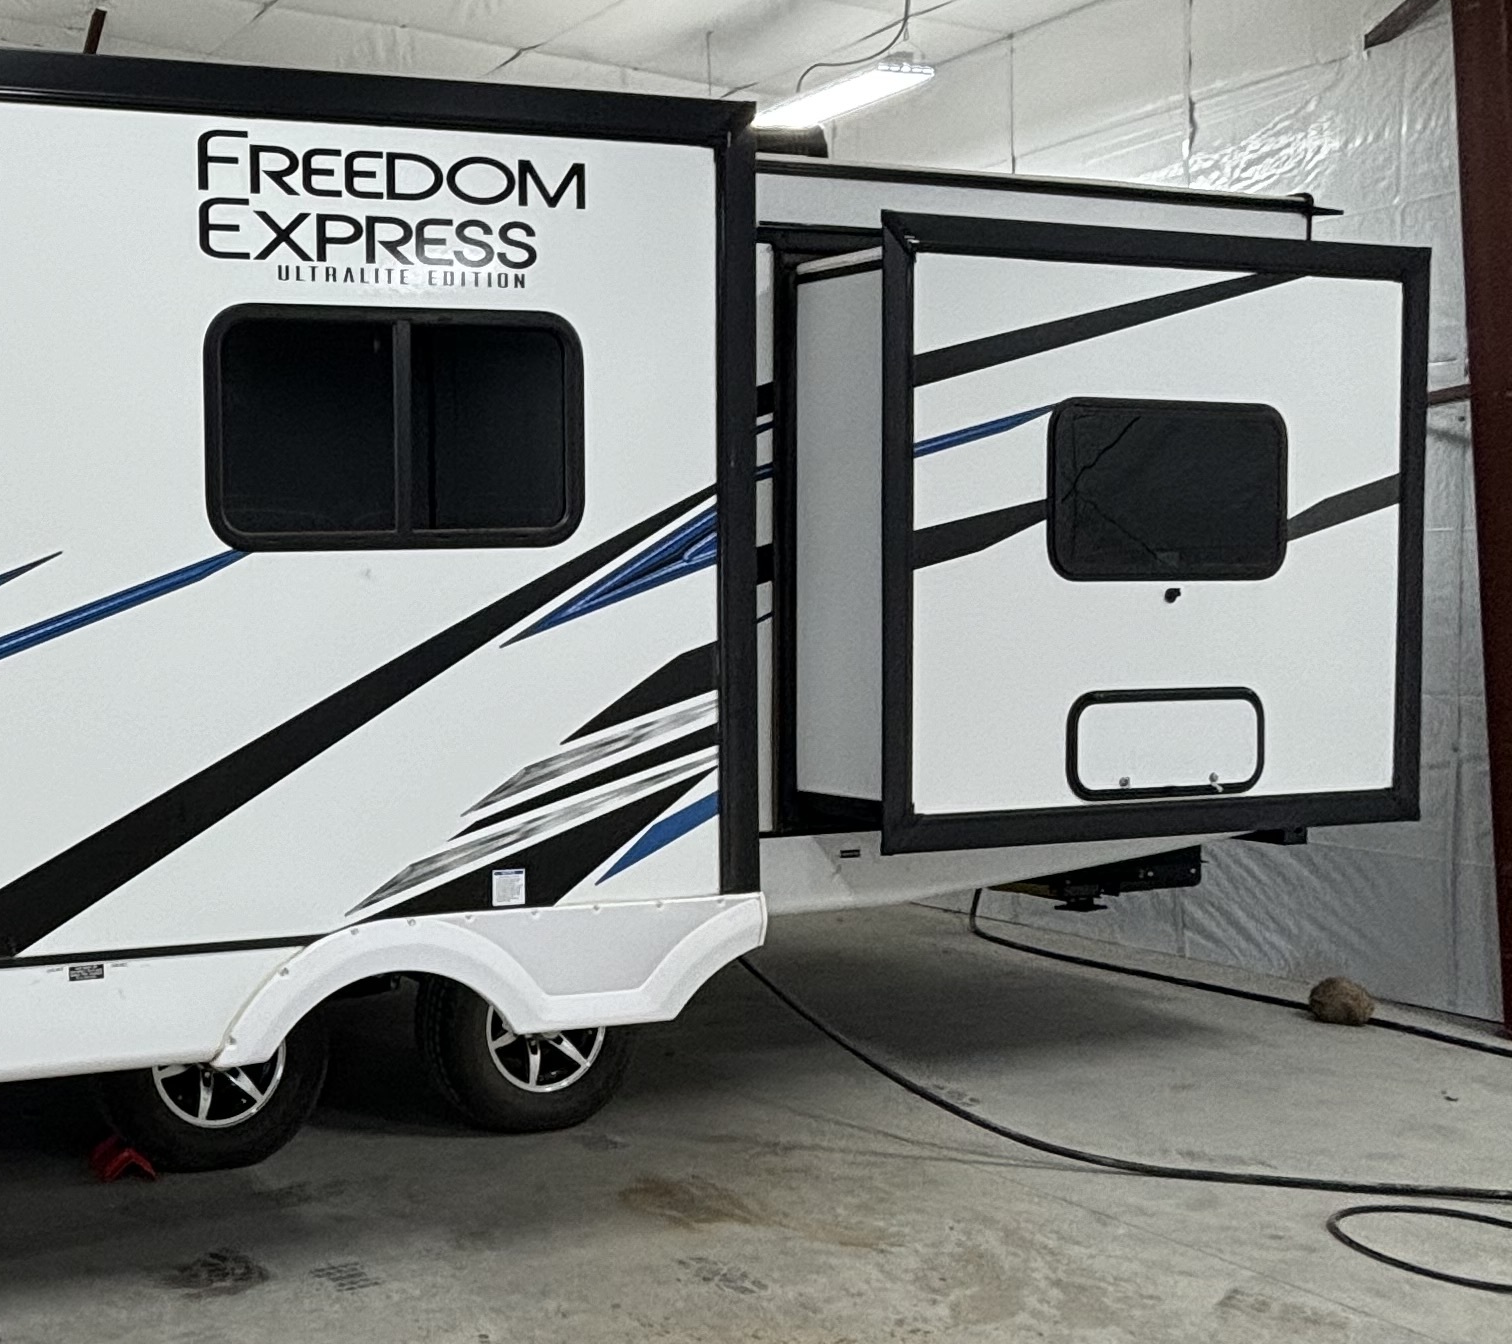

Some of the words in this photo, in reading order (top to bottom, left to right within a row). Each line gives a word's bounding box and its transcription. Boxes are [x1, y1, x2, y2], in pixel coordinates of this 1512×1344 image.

[196, 129, 586, 210] FREEDOM
[197, 197, 538, 270] EXPRESS
[276, 264, 410, 286] ULTRALITE
[427, 269, 527, 289] EDITION
